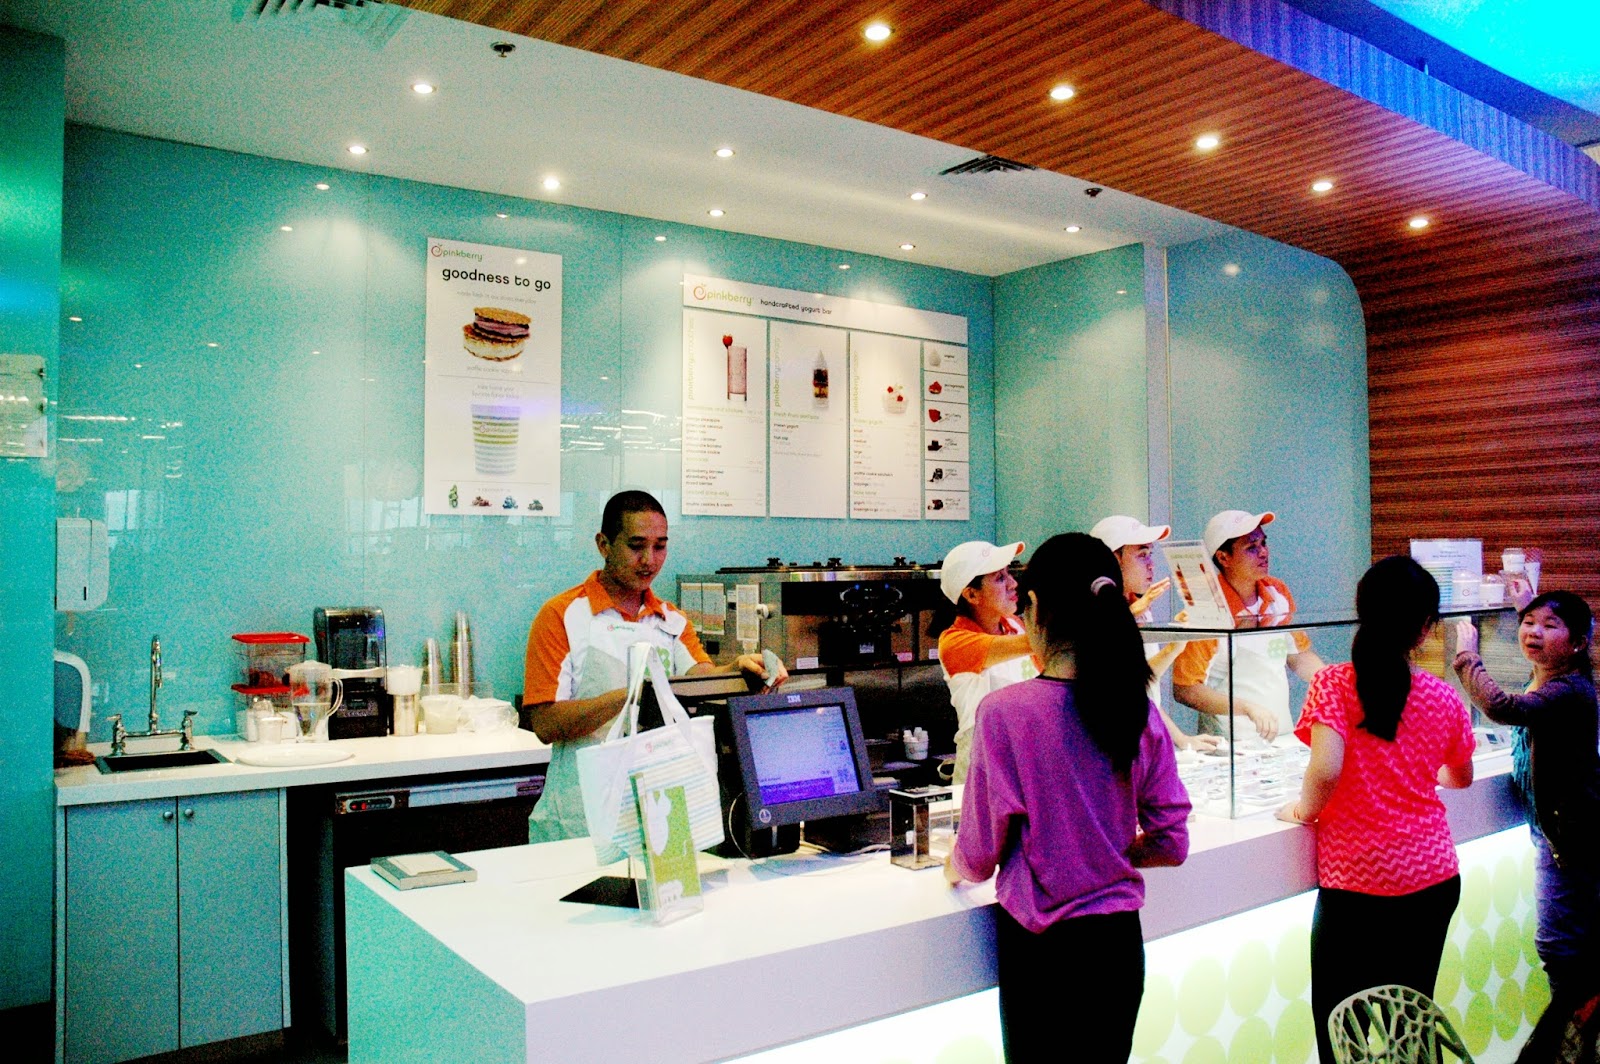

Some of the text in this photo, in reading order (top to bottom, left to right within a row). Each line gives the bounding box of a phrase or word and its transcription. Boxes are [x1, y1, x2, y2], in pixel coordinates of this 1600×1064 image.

[443, 249, 483, 262] pinkberry
[442, 268, 551, 292] goodness to go
[706, 289, 832, 315] pinkberry handcrafted yogurt bar
[786, 694, 802, 703] IBM
